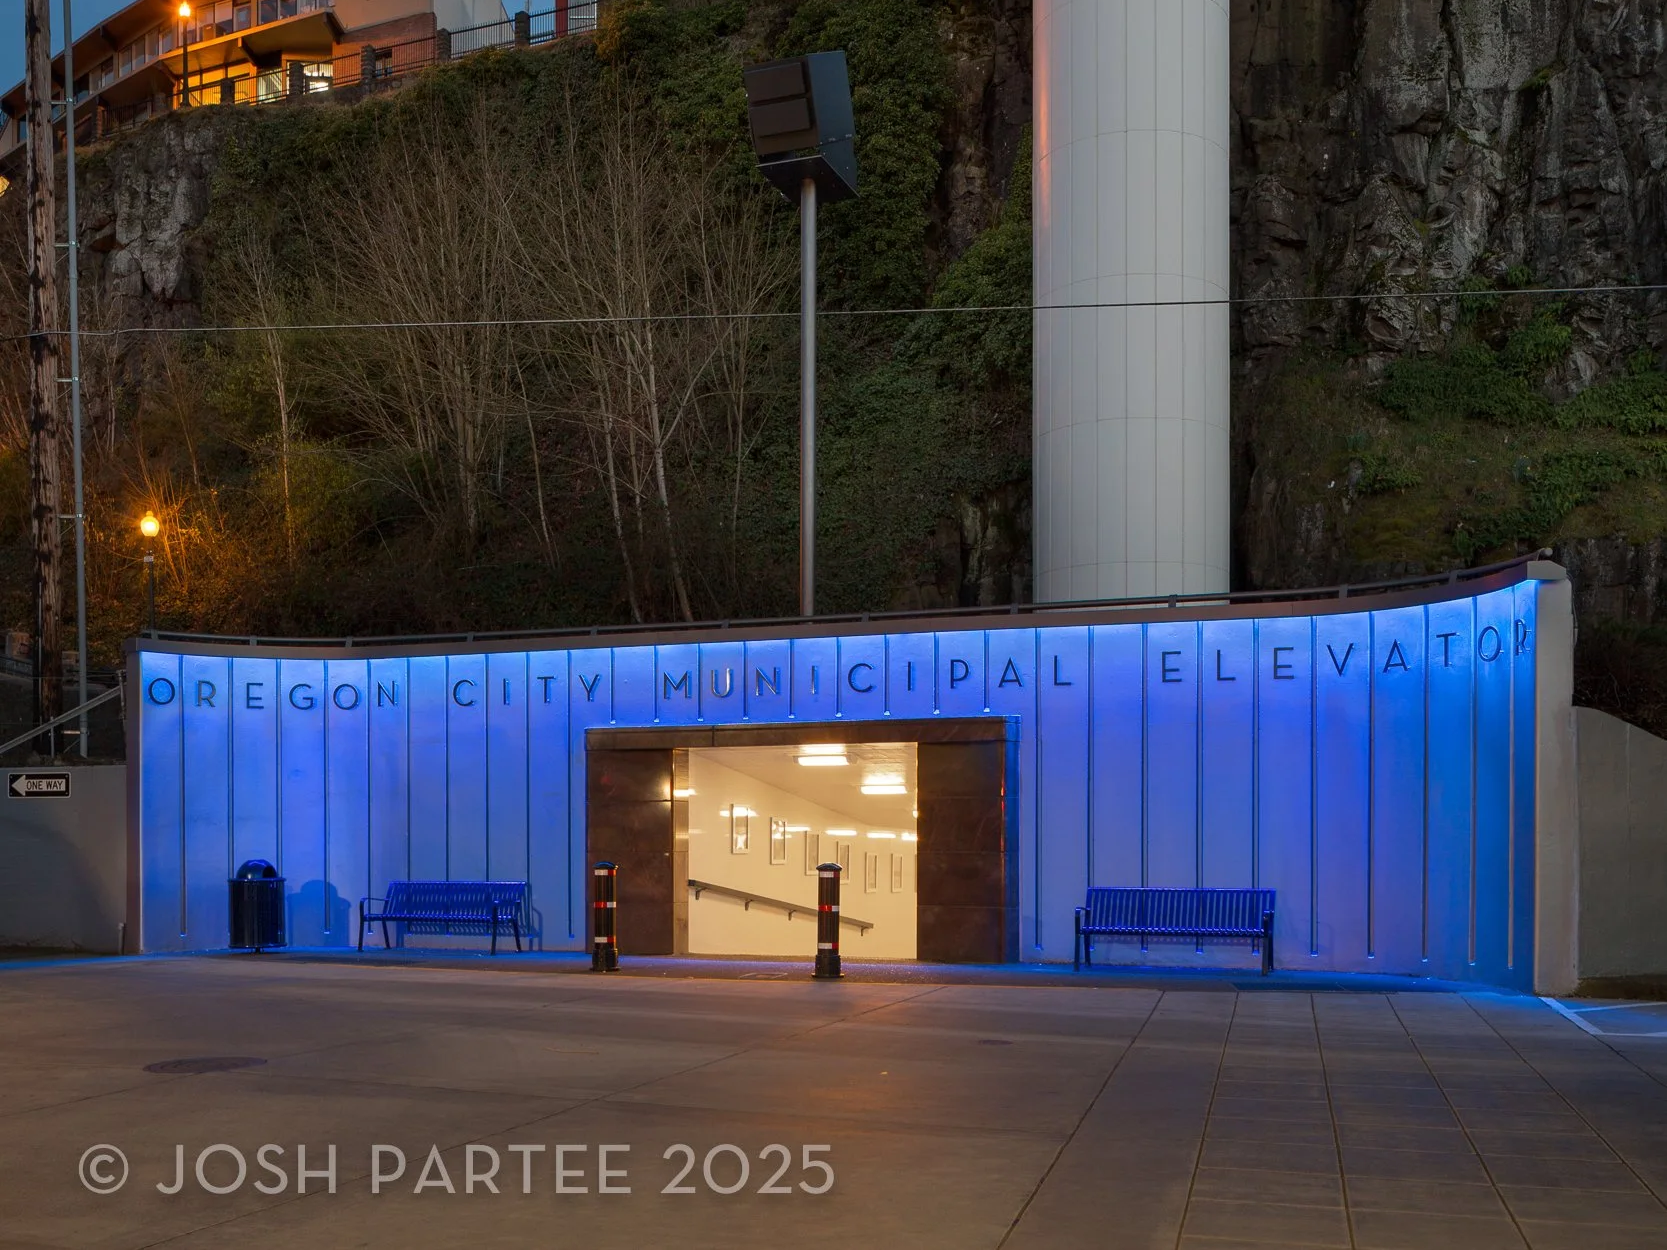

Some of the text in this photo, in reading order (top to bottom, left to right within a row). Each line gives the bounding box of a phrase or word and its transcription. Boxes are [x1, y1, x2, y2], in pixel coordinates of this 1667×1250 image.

[148, 618, 1532, 711] OREGON CITY MUNICIPAL ELEVATOR
[26, 780, 63, 790] ONE WAY
